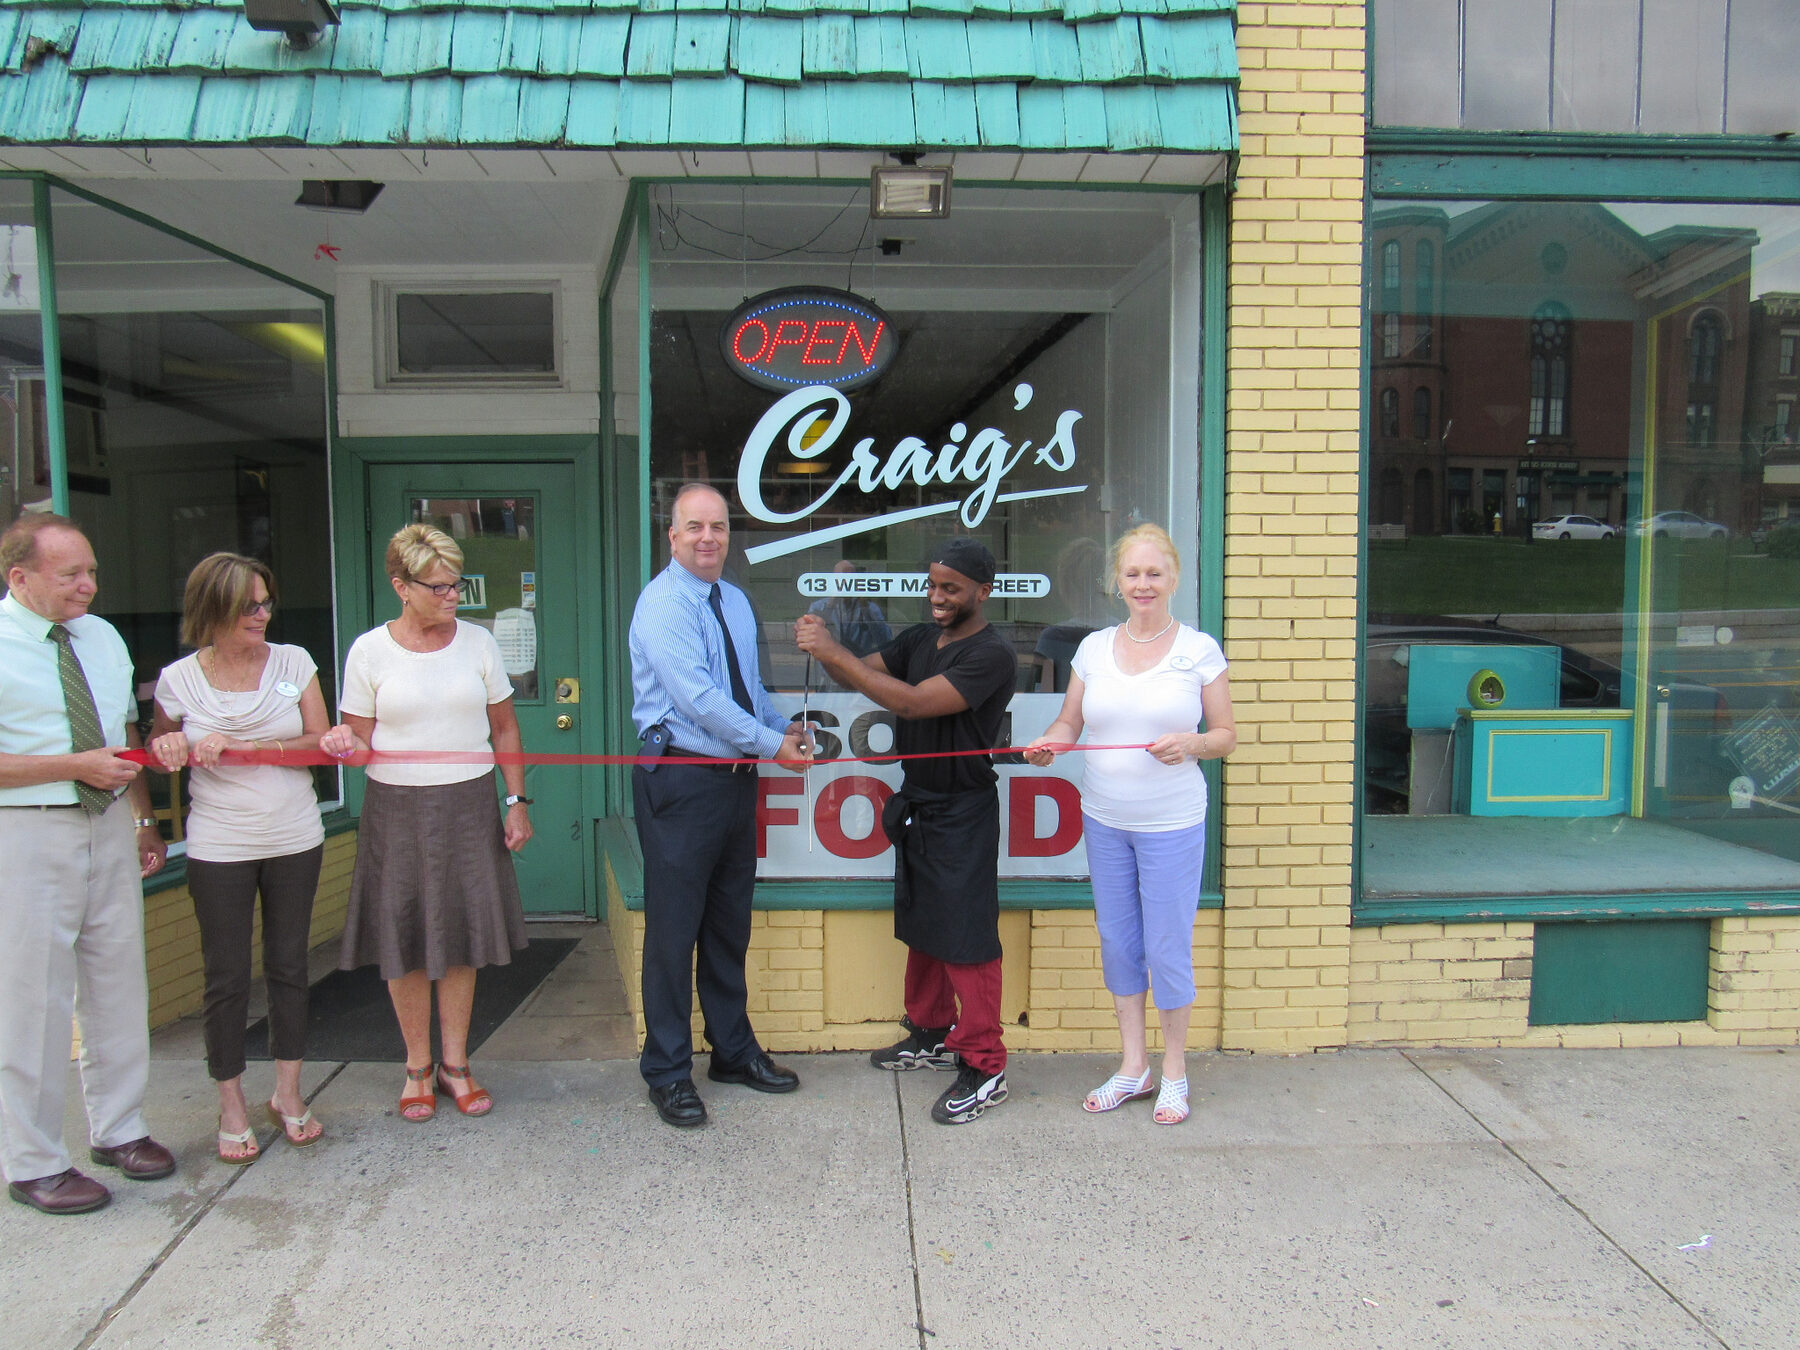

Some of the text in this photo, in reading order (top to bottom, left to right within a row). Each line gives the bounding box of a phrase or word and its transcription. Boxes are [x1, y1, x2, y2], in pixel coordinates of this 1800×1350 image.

[733, 318, 885, 365] OPEN
[737, 383, 1083, 529] Craig's
[803, 578, 1042, 593] 13 WEST MA REET
[790, 710, 1030, 765] SOL
[756, 775, 1084, 859] FOD
